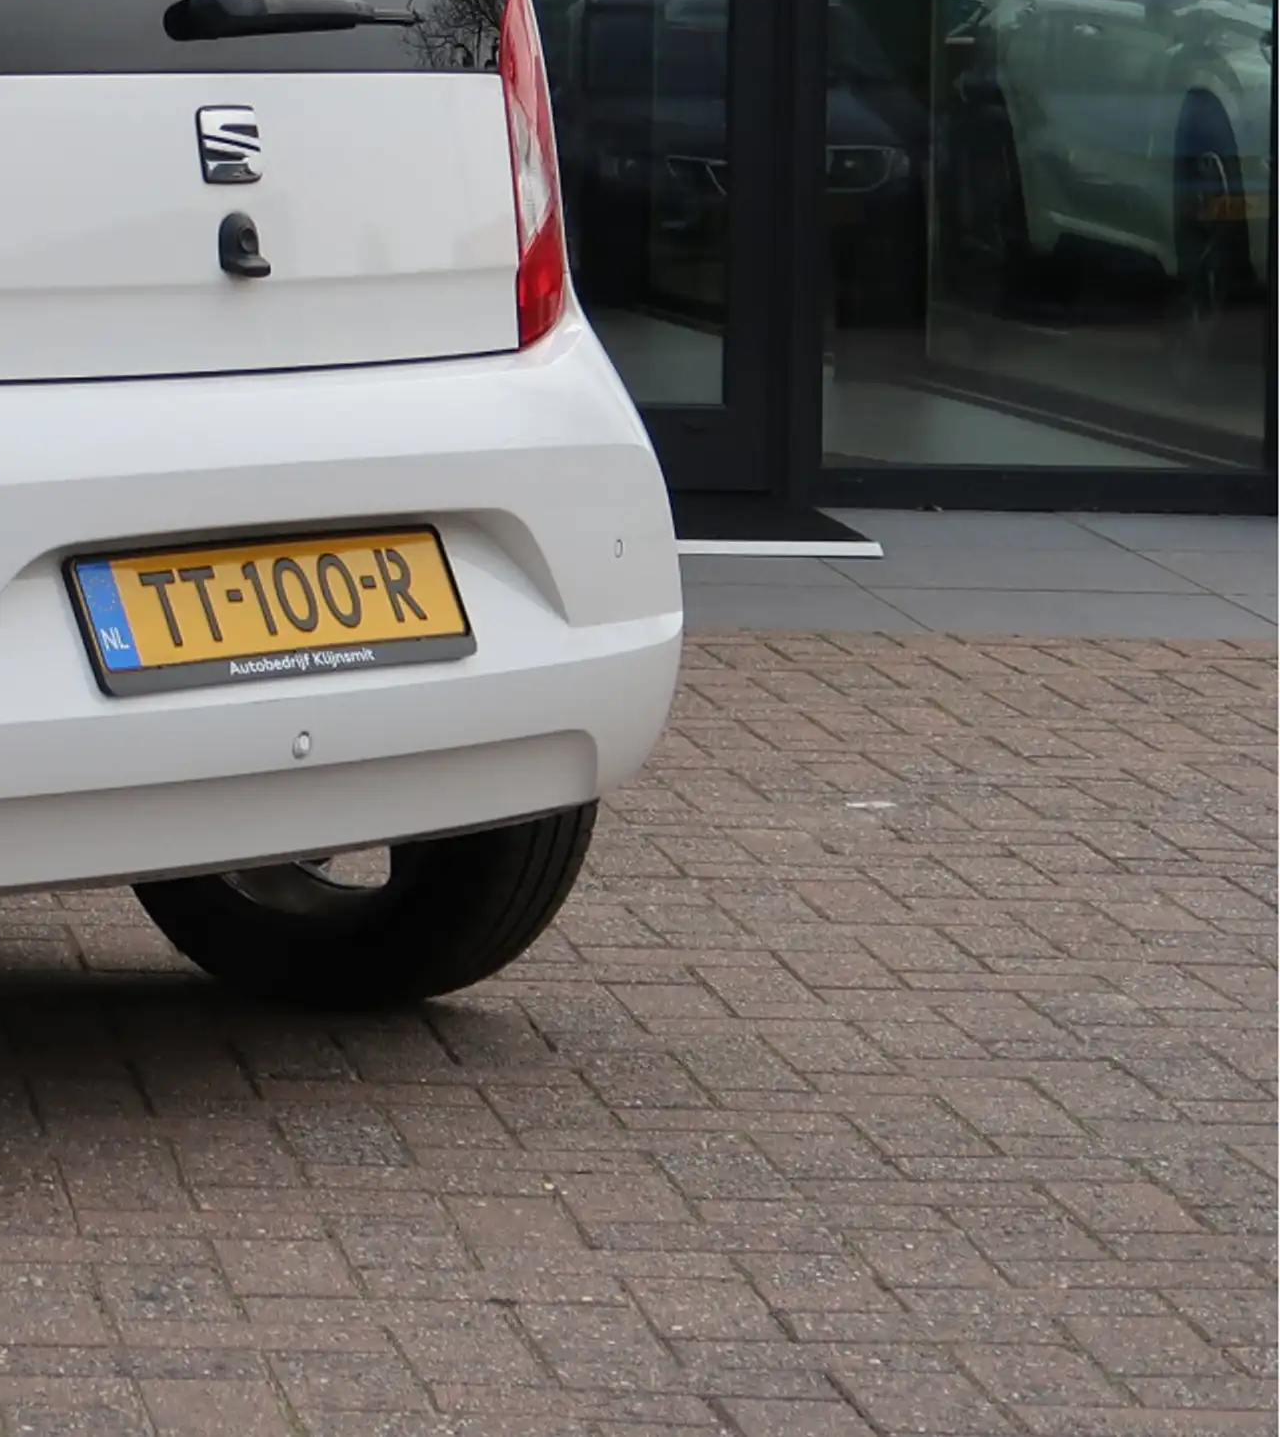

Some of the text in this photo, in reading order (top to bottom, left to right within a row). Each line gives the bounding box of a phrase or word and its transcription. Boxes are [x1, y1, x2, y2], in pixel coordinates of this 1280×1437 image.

[140, 547, 428, 647] TT-100-R
[100, 627, 130, 651] NL
[229, 647, 376, 676] Autobedrijf Klijnsmit
